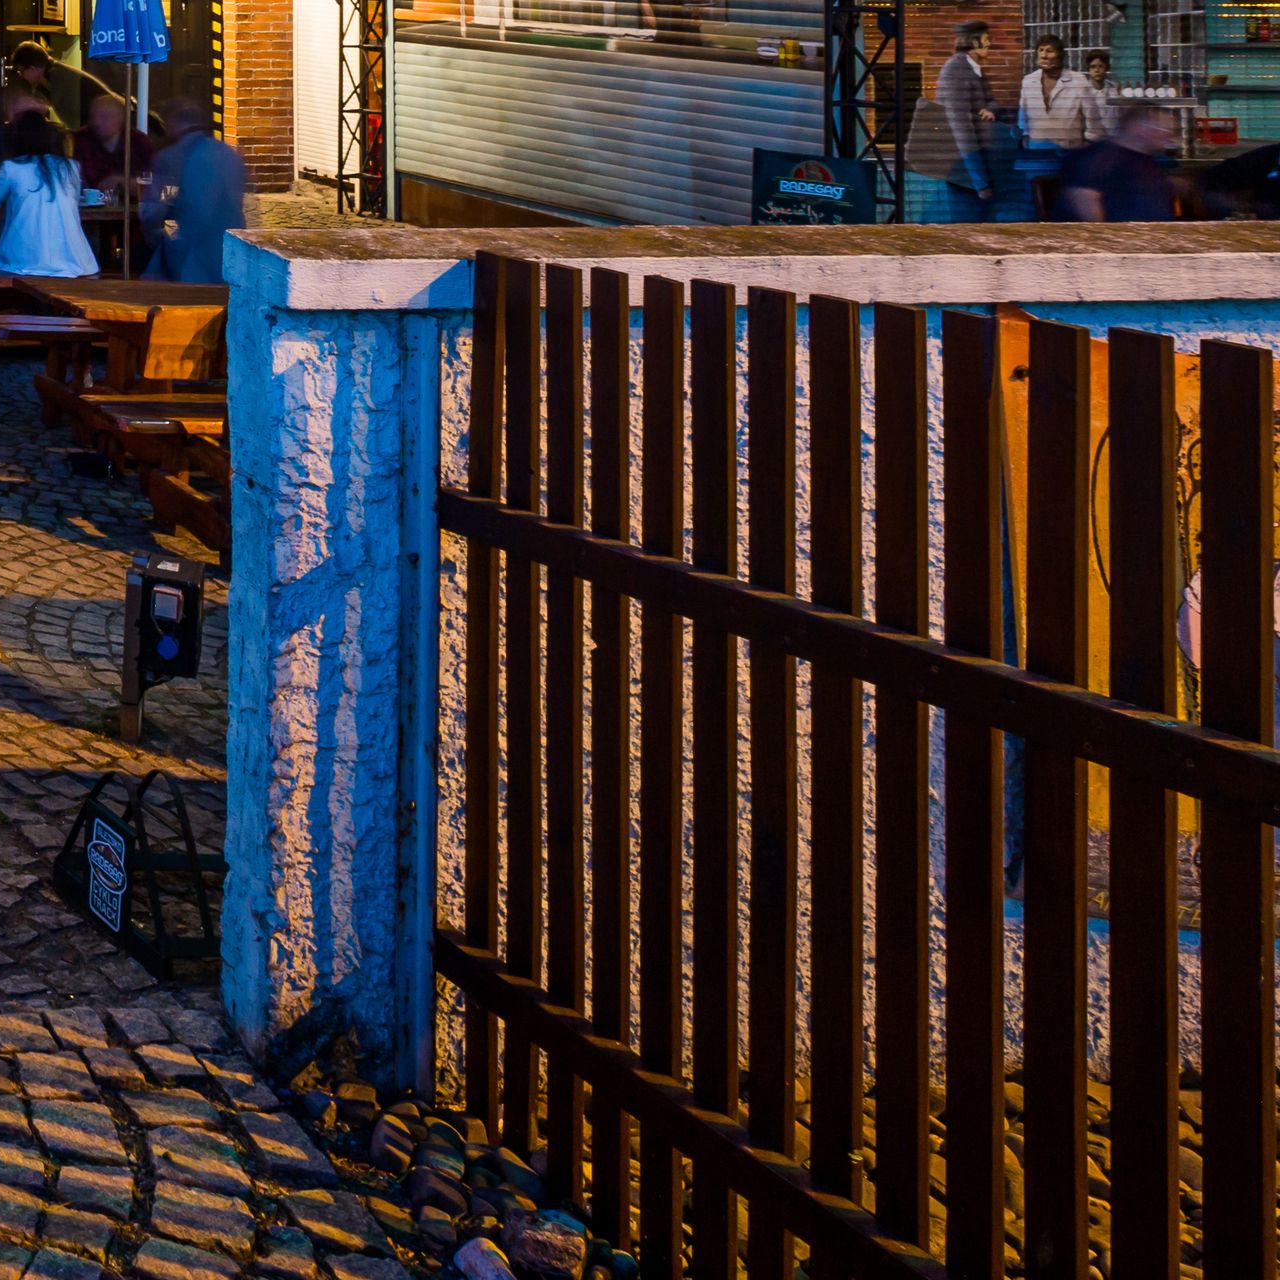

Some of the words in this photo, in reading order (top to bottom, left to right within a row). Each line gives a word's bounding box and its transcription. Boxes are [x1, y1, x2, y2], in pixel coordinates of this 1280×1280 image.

[780, 180, 846, 199] RADEGAST
[93, 880, 118, 911] CYKLO
[93, 895, 117, 925] TRACK
